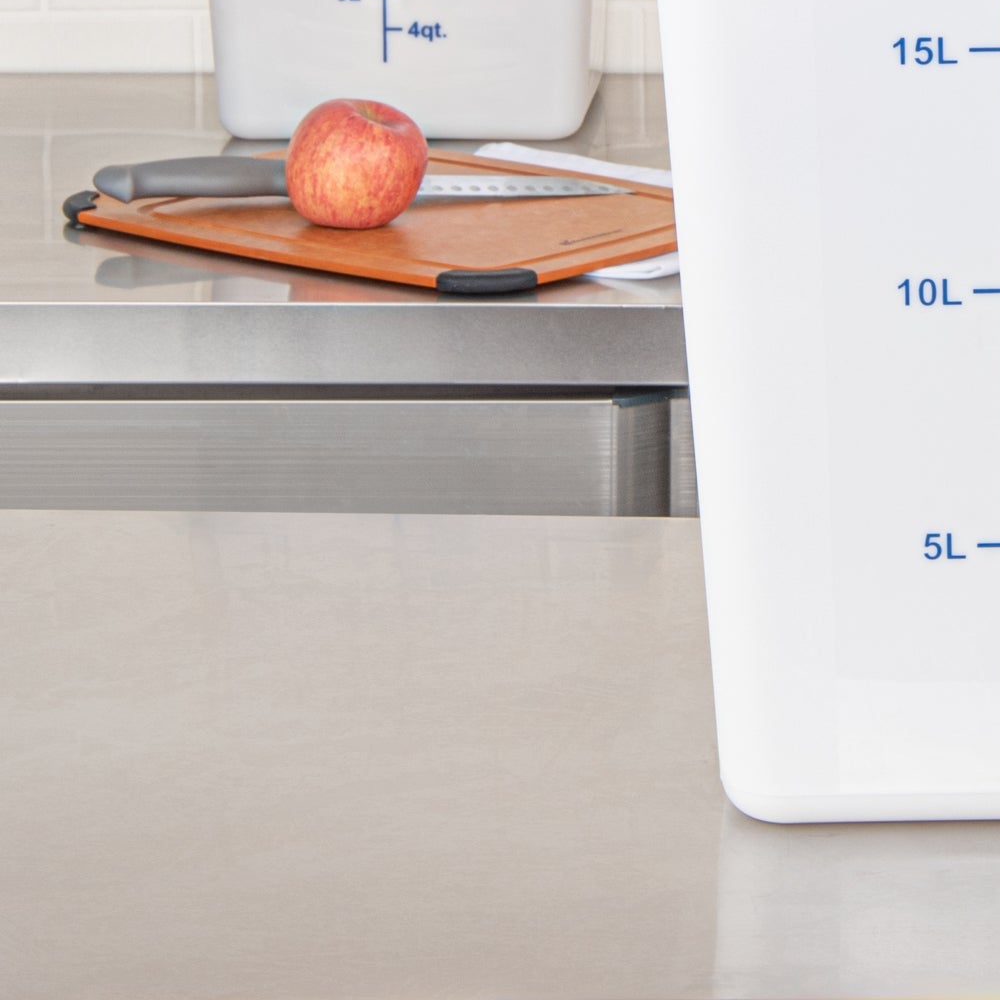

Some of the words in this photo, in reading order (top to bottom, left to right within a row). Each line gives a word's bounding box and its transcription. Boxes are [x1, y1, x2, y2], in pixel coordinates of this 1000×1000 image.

[407, 20, 448, 41] 4qt.
[893, 36, 959, 66] 15L
[898, 278, 963, 306] 10L
[923, 531, 967, 560] 5L
